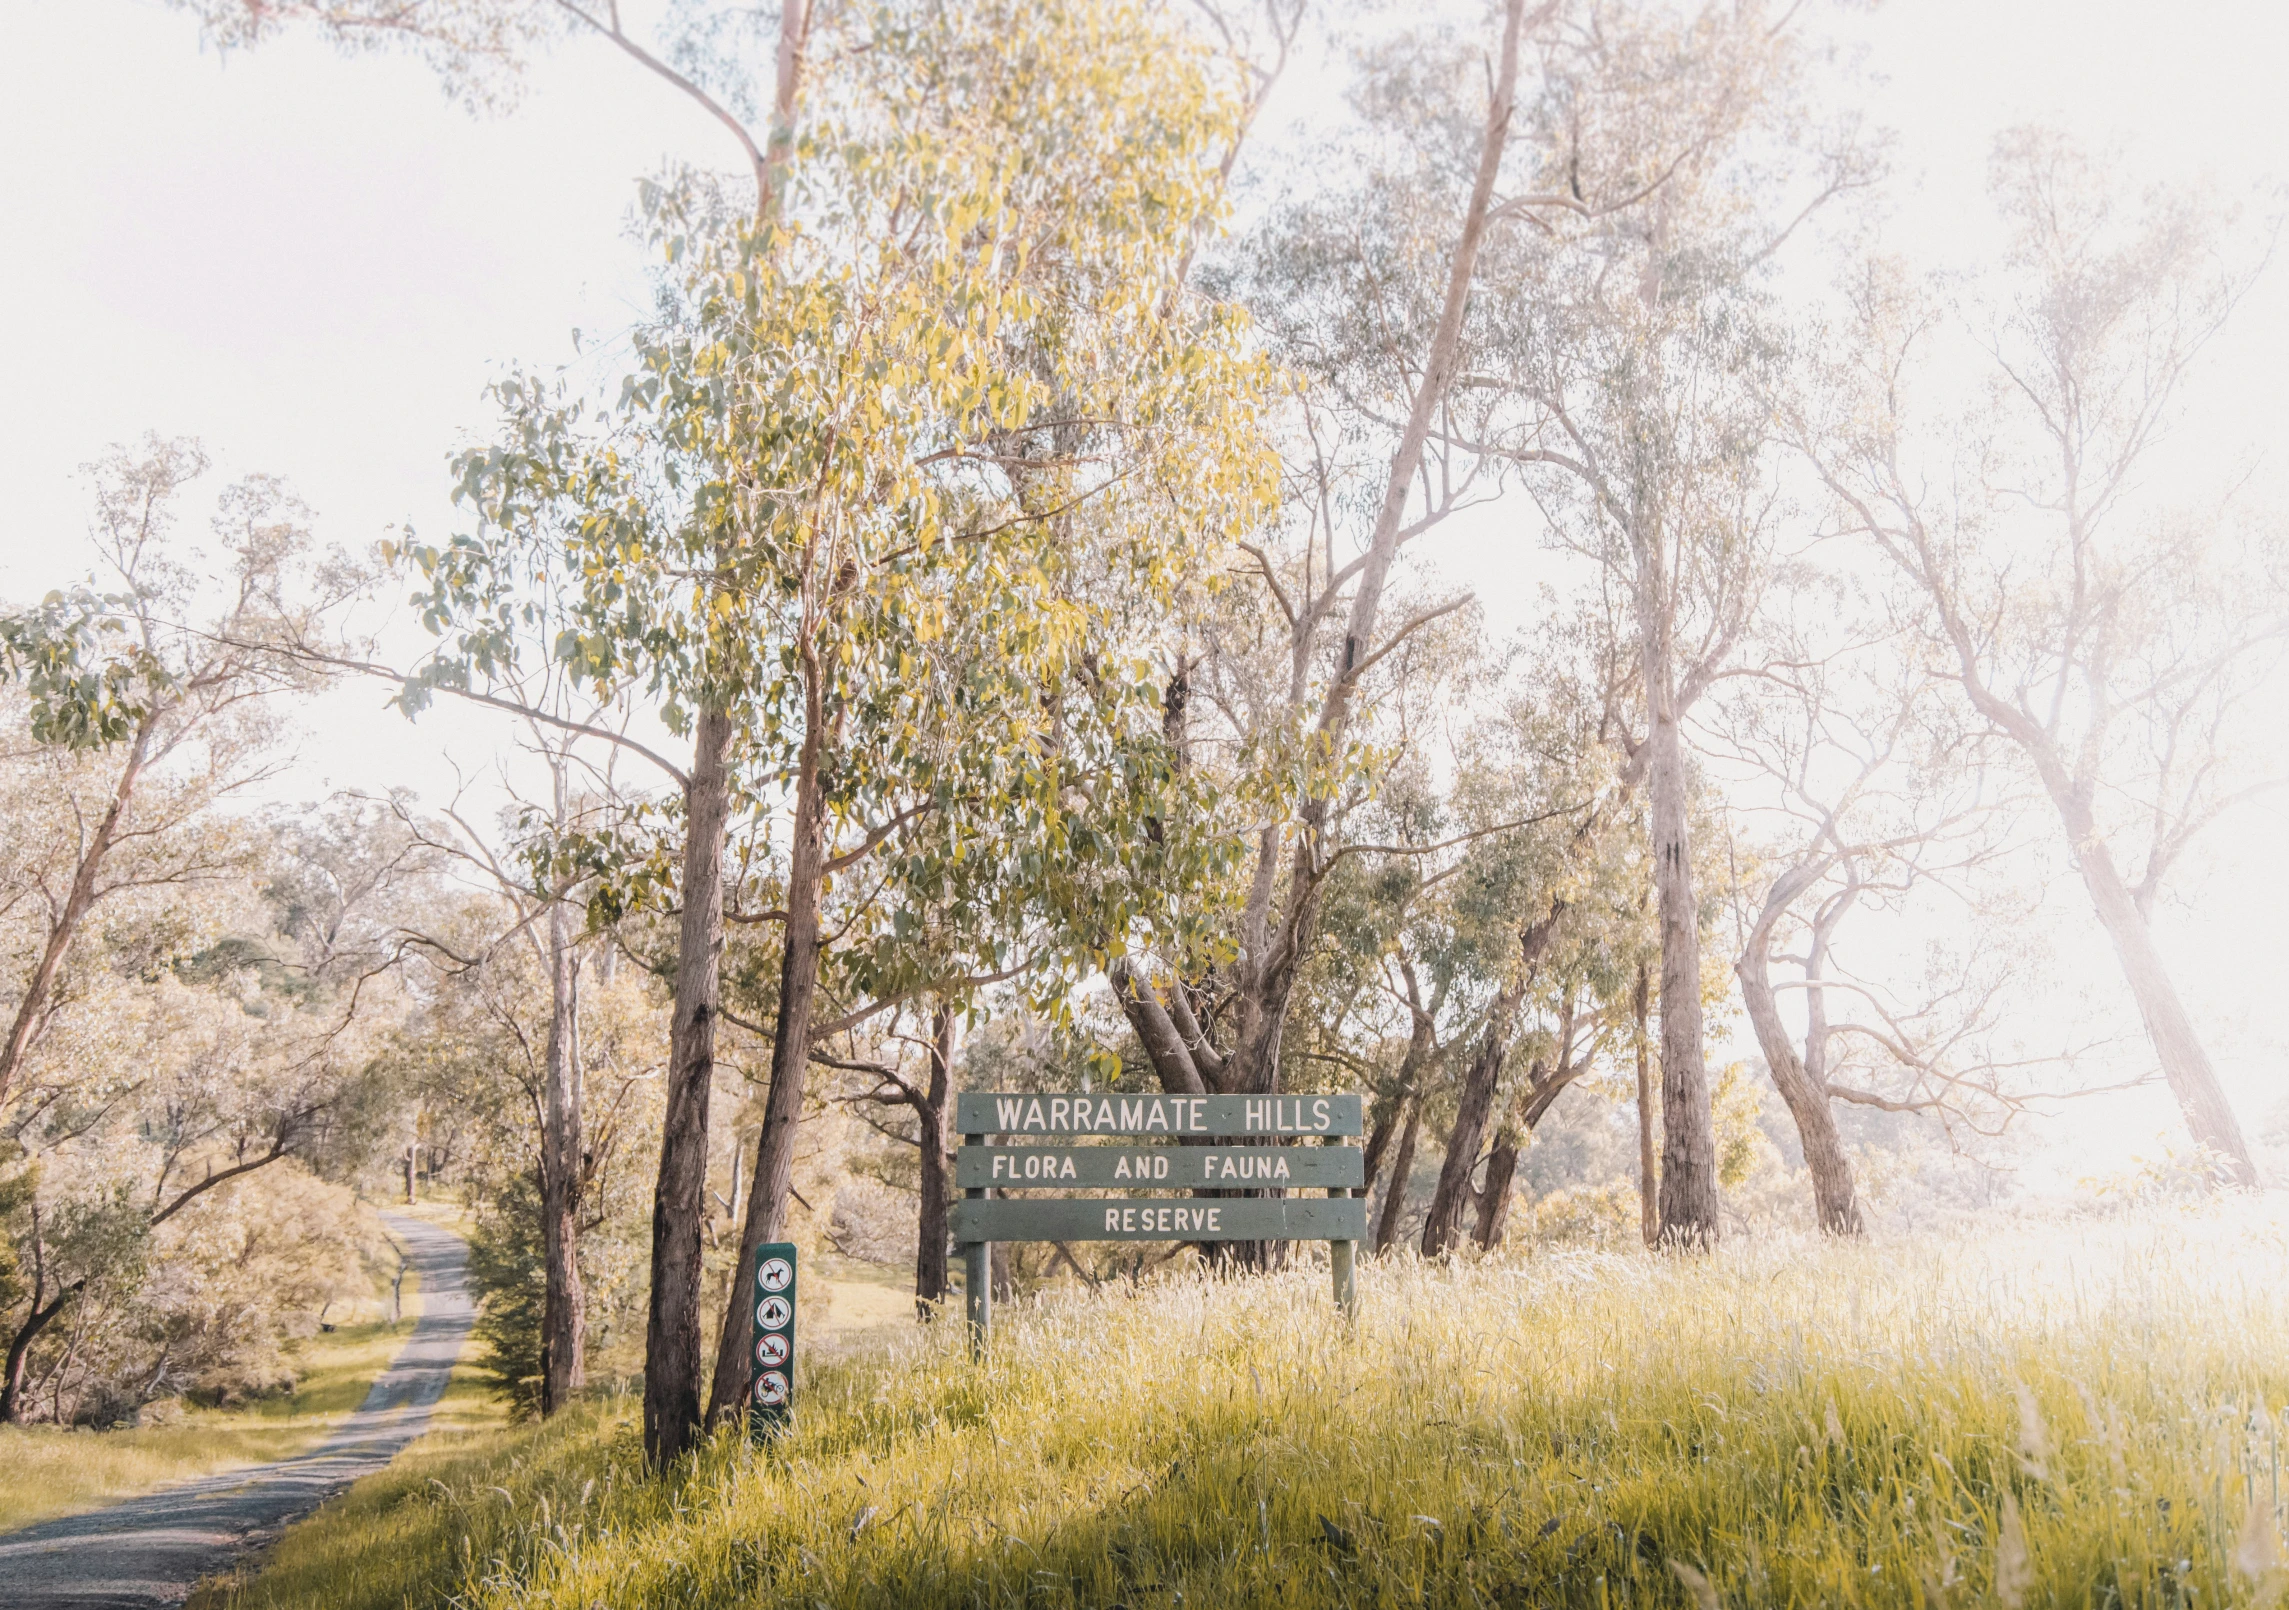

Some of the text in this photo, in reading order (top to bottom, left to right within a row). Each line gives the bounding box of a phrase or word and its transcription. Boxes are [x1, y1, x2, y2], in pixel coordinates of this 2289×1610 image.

[996, 1098, 1331, 1132] WARRAMATE HILLS
[992, 1155, 1291, 1180] FLORA AND FAUNA
[1105, 1208, 1222, 1232] RESERVE
